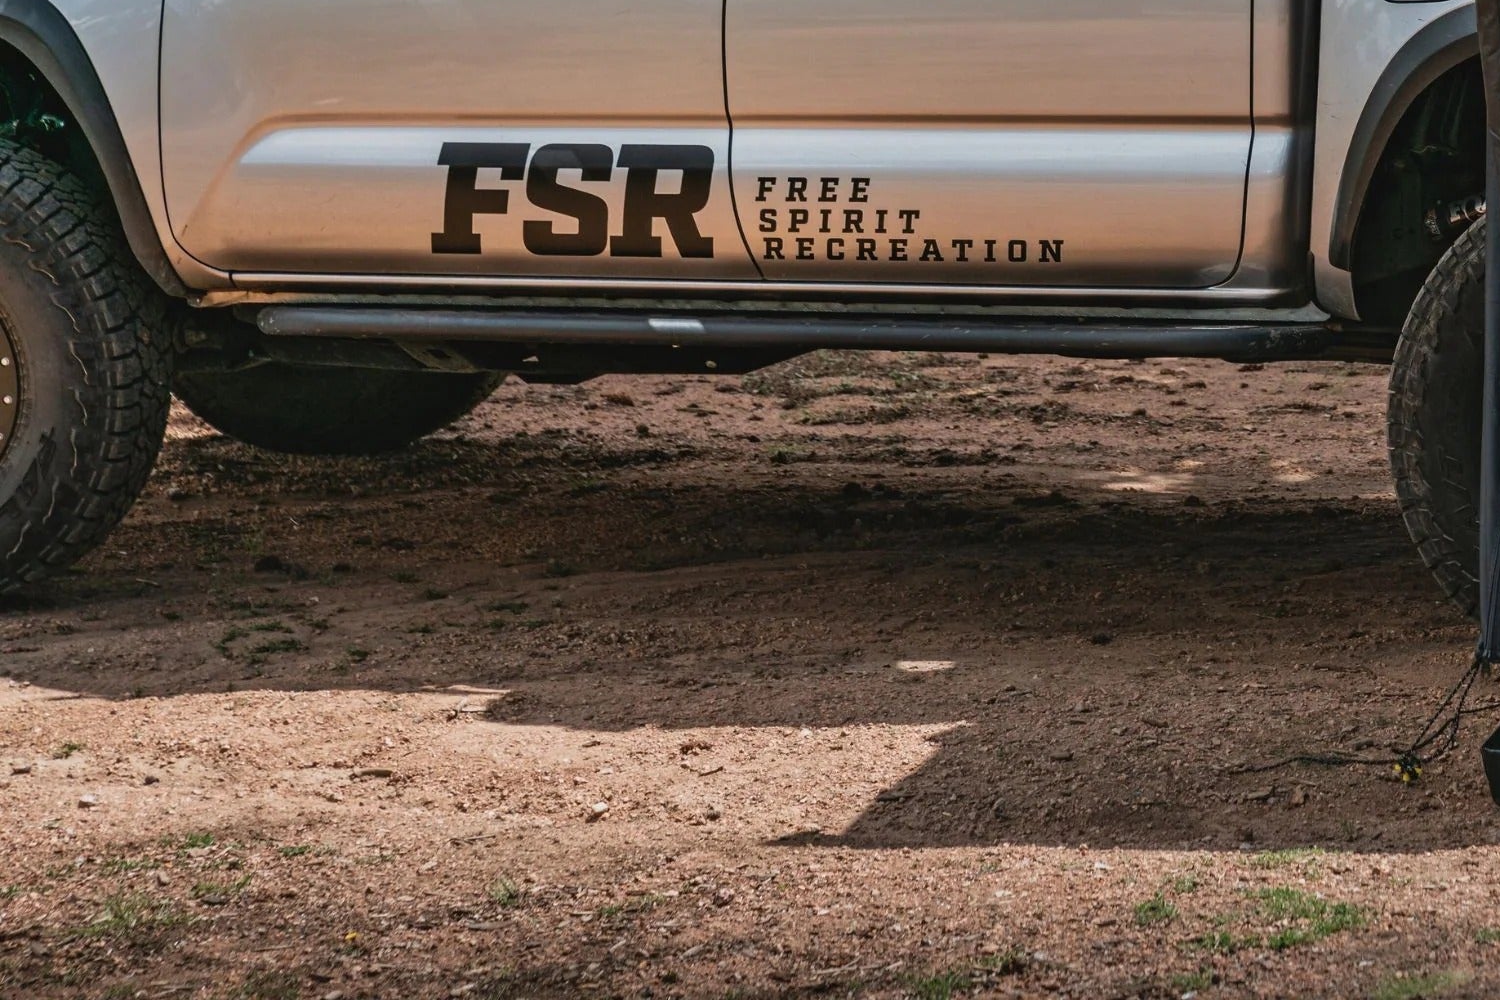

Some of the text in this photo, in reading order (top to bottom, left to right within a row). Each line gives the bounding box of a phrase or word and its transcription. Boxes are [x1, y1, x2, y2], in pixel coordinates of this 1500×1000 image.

[430, 141, 716, 259] FSR
[755, 176, 872, 203] FREE
[758, 209, 921, 234] SPIRIT
[763, 237, 1065, 263] RECREATION
